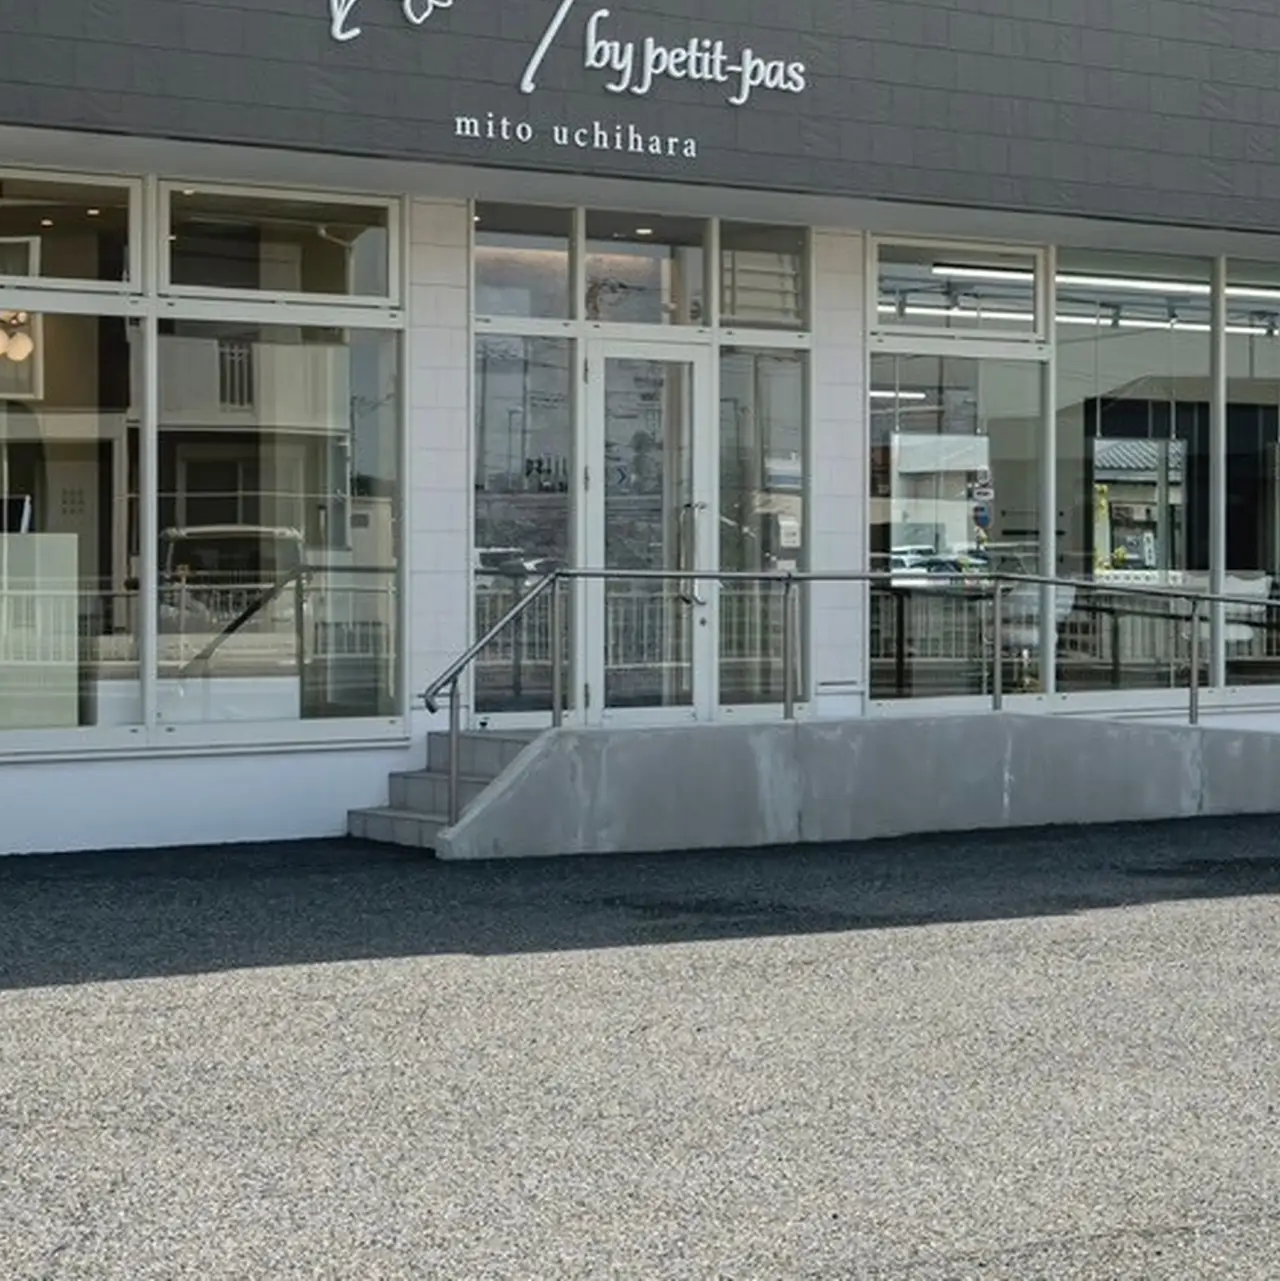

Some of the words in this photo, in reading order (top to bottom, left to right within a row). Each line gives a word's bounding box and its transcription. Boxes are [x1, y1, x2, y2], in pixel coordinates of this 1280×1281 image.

[584, 8, 635, 92] by
[632, 36, 806, 105] petit-pas
[455, 111, 533, 142] mito
[553, 120, 697, 158] uchihara
